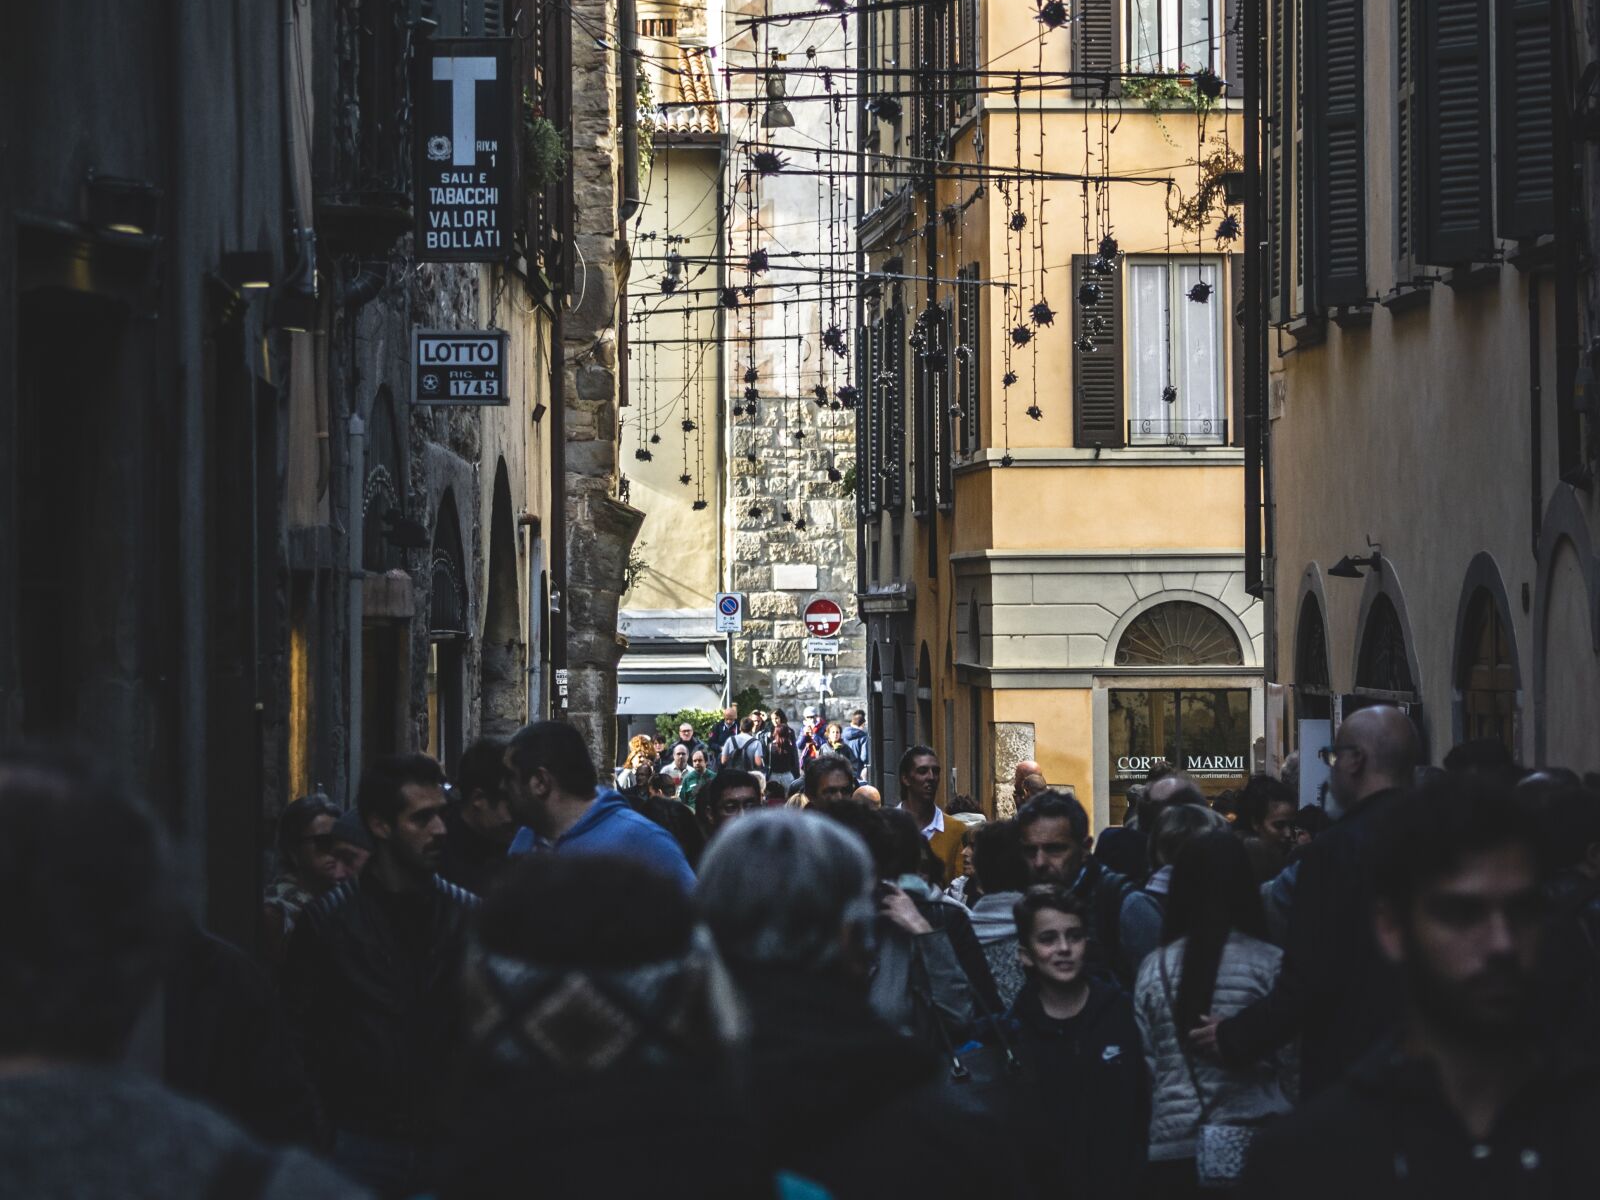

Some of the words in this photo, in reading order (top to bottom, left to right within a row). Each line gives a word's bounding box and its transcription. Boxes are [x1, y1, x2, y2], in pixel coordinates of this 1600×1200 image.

[432, 56, 497, 166] T
[490, 154, 496, 167] 1
[441, 172, 473, 184] SALI
[479, 172, 487, 184] E
[429, 187, 498, 205] TABACCHI
[429, 209, 496, 228] VALORI
[427, 230, 500, 249] BOLLATI
[424, 342, 494, 362] LOTTO
[453, 381, 495, 395] 1745
[1187, 756, 1244, 769] MARMI
